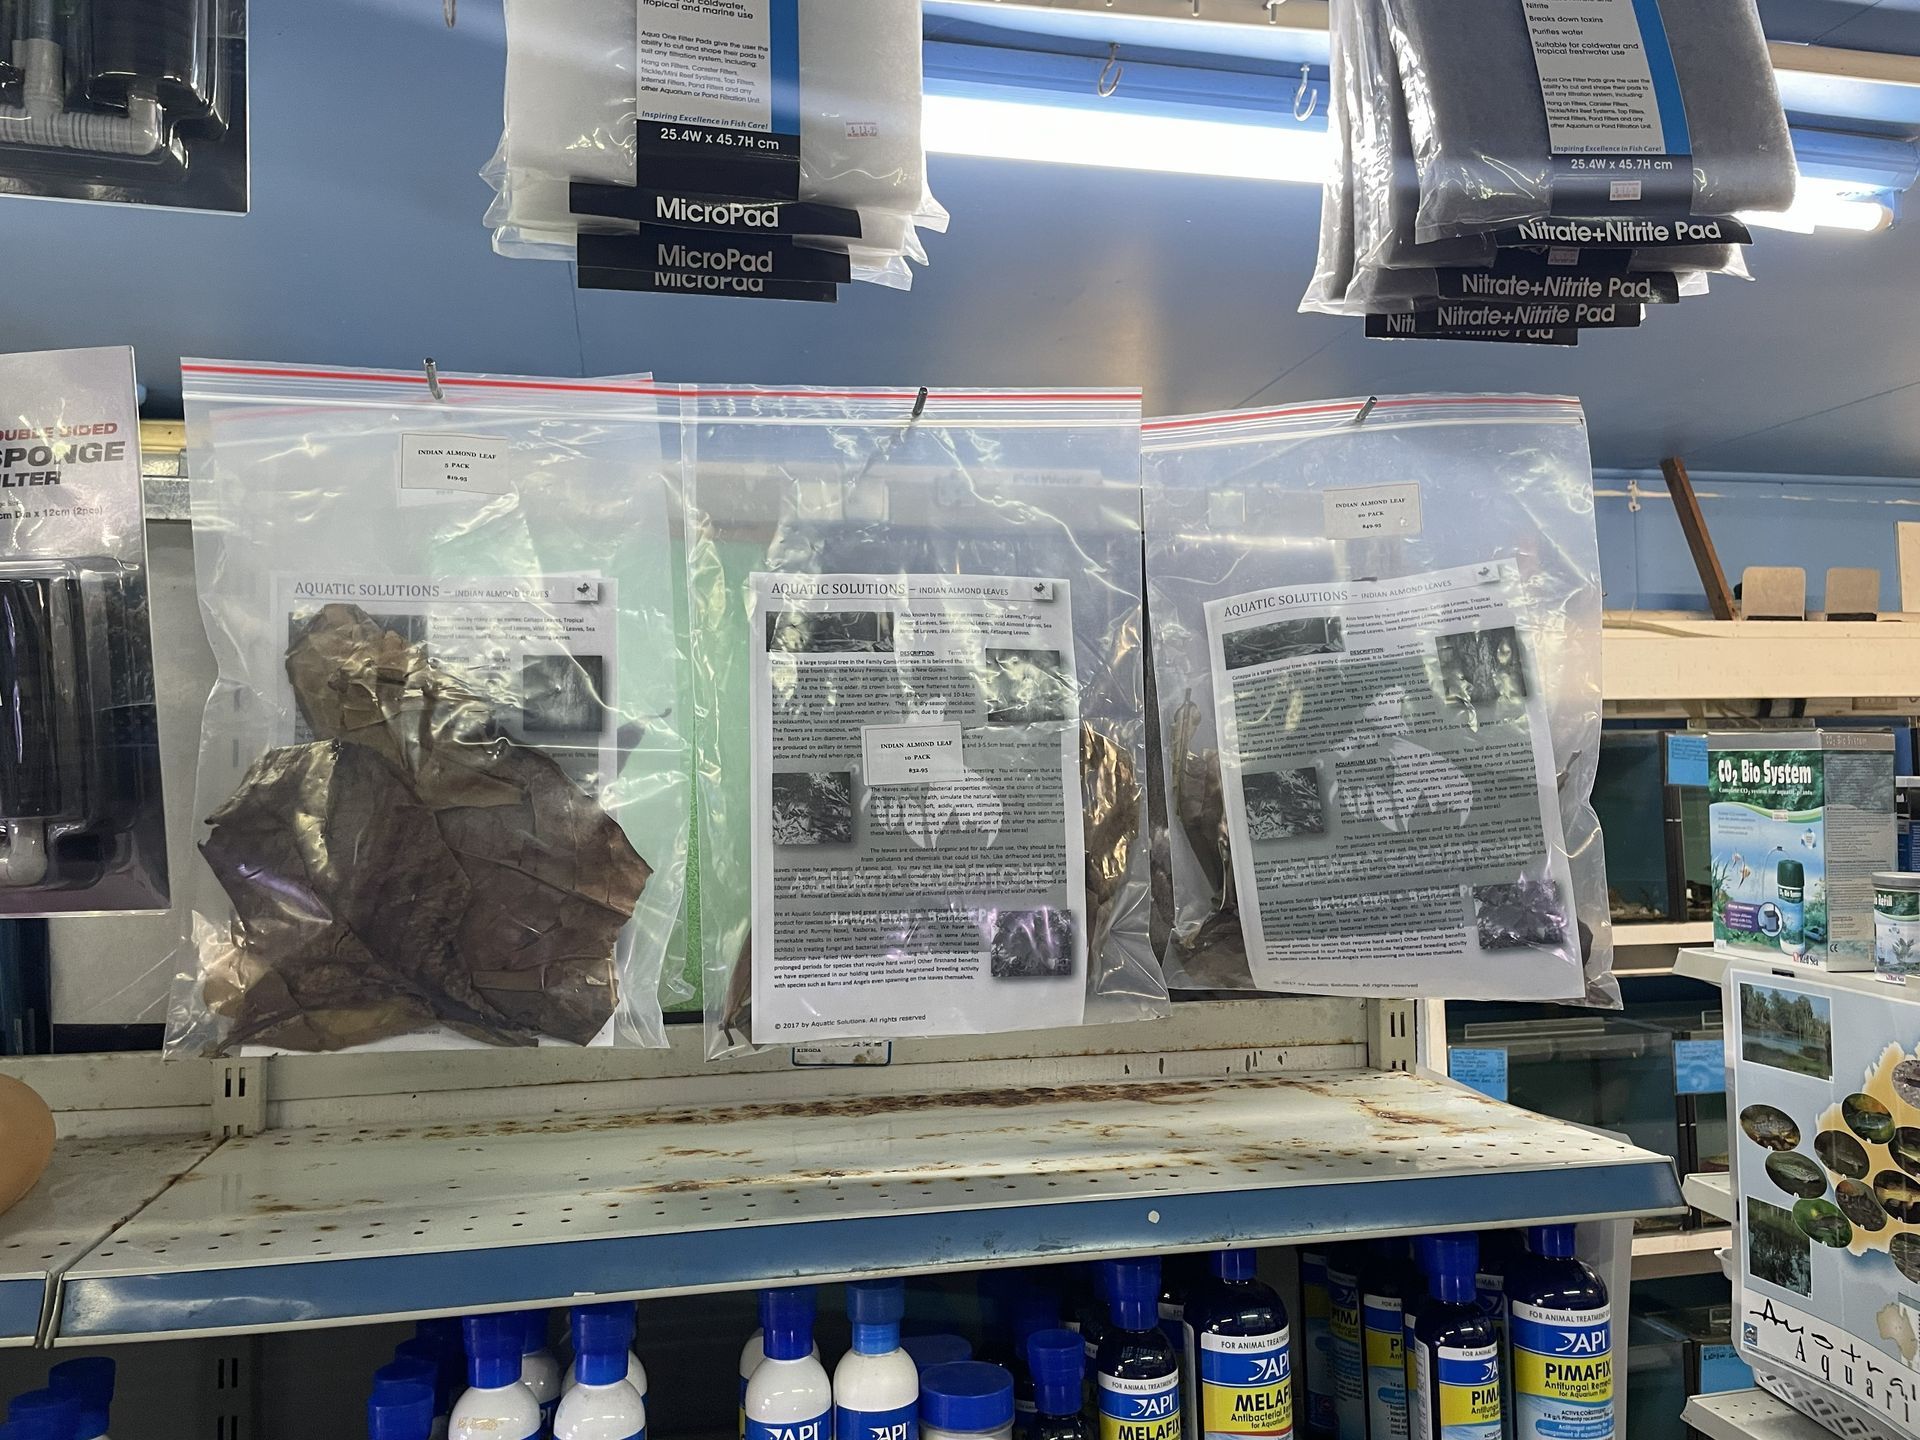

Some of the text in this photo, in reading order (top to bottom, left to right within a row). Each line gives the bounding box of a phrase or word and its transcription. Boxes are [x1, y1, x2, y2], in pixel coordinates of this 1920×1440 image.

[682, 4, 699, 12] and
[703, 7, 734, 16] marine
[642, 30, 660, 38] Aqua
[679, 34, 694, 42] Filter
[642, 111, 677, 121] Inspiring
[680, 114, 719, 125] Excellence
[661, 128, 779, 150] 25.4W x 45.7H cm
[1571, 159, 1672, 169] 25.4W x 45.7H cm
[657, 196, 779, 227] MicroPad
[1518, 221, 1721, 242] Nitrate+Nitrite Pad
[658, 244, 773, 273] MicroPad
[1462, 274, 1651, 298] Nitrate+Nitrite Pad
[1438, 304, 1615, 326] Nitrate+Nitrite Pad
[58, 423, 117, 438] SIDED
[0, 441, 125, 467] PONGE
[0, 471, 61, 487] LTER
[43, 508, 70, 517] 12cm
[295, 581, 356, 597] AQUATIC
[359, 583, 440, 597] SOLUTIONS
[455, 590, 484, 598] INDIAN
[486, 590, 519, 598] ALMOND
[772, 583, 830, 595] AQUATIC
[833, 583, 905, 595] SOLUTIONS
[1224, 580, 1452, 617] AQUATIC SOLUTIONS INDIAN ALMOND LEAVES
[1742, 760, 1760, 784] Bio
[1764, 760, 1811, 786] System
[1810, 956, 1819, 966] Sea
[811, 1019, 834, 1028] Aquatic
[837, 1017, 867, 1025] Solutions.
[1530, 1311, 1542, 1319] FOR
[1546, 1312, 1574, 1322] ANIMAL
[1222, 1340, 1265, 1349] FOR ANIMAL
[1572, 1330, 1606, 1353] API
[1264, 1350, 1289, 1379] API
[1546, 1359, 1611, 1381] PIMAFIX
[1545, 1381, 1589, 1392] Antifungal
[1570, 1390, 1598, 1398] Aquarium
[1144, 1394, 1172, 1416] API
[1231, 1409, 1282, 1421] Antibacterial
[876, 1423, 906, 1440] API
[1119, 1418, 1179, 1440] MELAFIX
